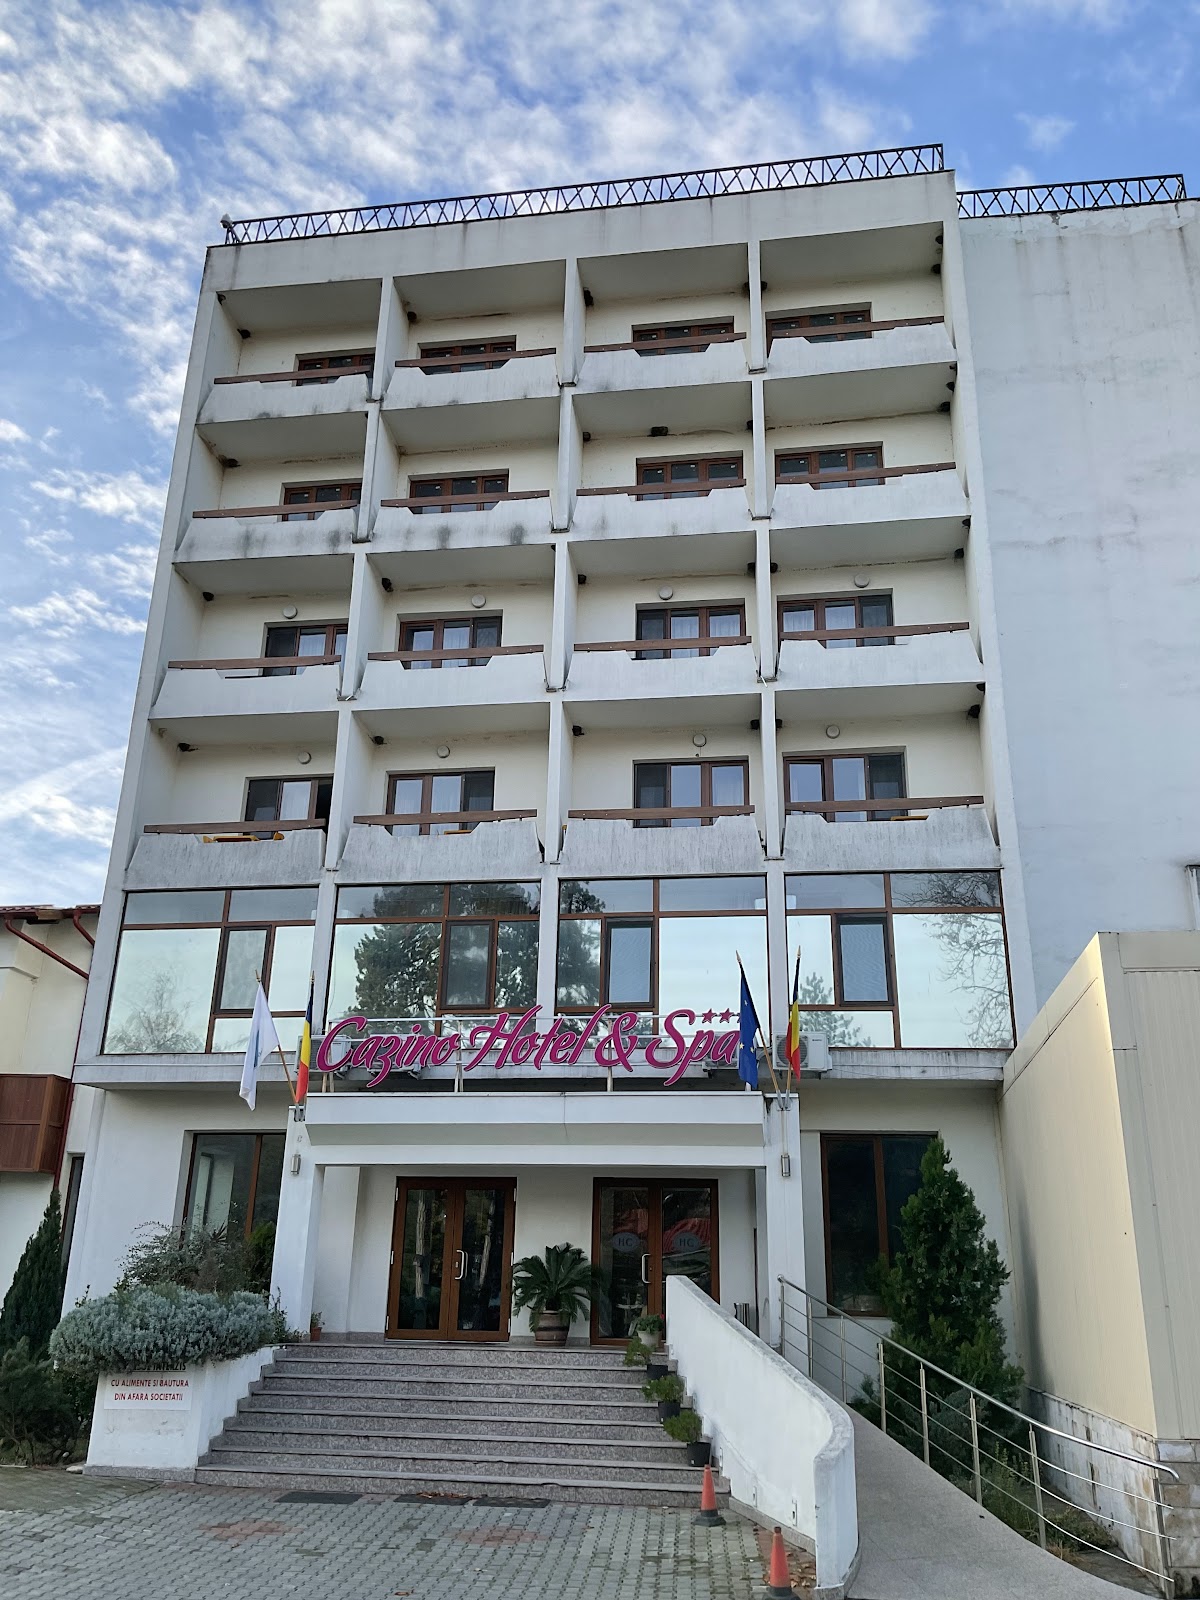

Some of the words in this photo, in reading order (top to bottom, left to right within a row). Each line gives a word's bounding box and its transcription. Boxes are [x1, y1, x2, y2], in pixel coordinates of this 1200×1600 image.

[316, 1015, 461, 1088] Cazino
[464, 1004, 612, 1071] Hotel
[594, 1011, 639, 1073] &
[644, 1008, 740, 1087] Spa
[618, 1237, 633, 1247] HC
[111, 1379, 119, 1387] CU
[121, 1379, 151, 1387] ALIMENTE
[152, 1379, 159, 1387] SI
[159, 1379, 189, 1387] BAUTURA
[114, 1393, 126, 1401] DIN
[127, 1393, 149, 1401] AFARA
[150, 1393, 183, 1401] SOCIETATII
